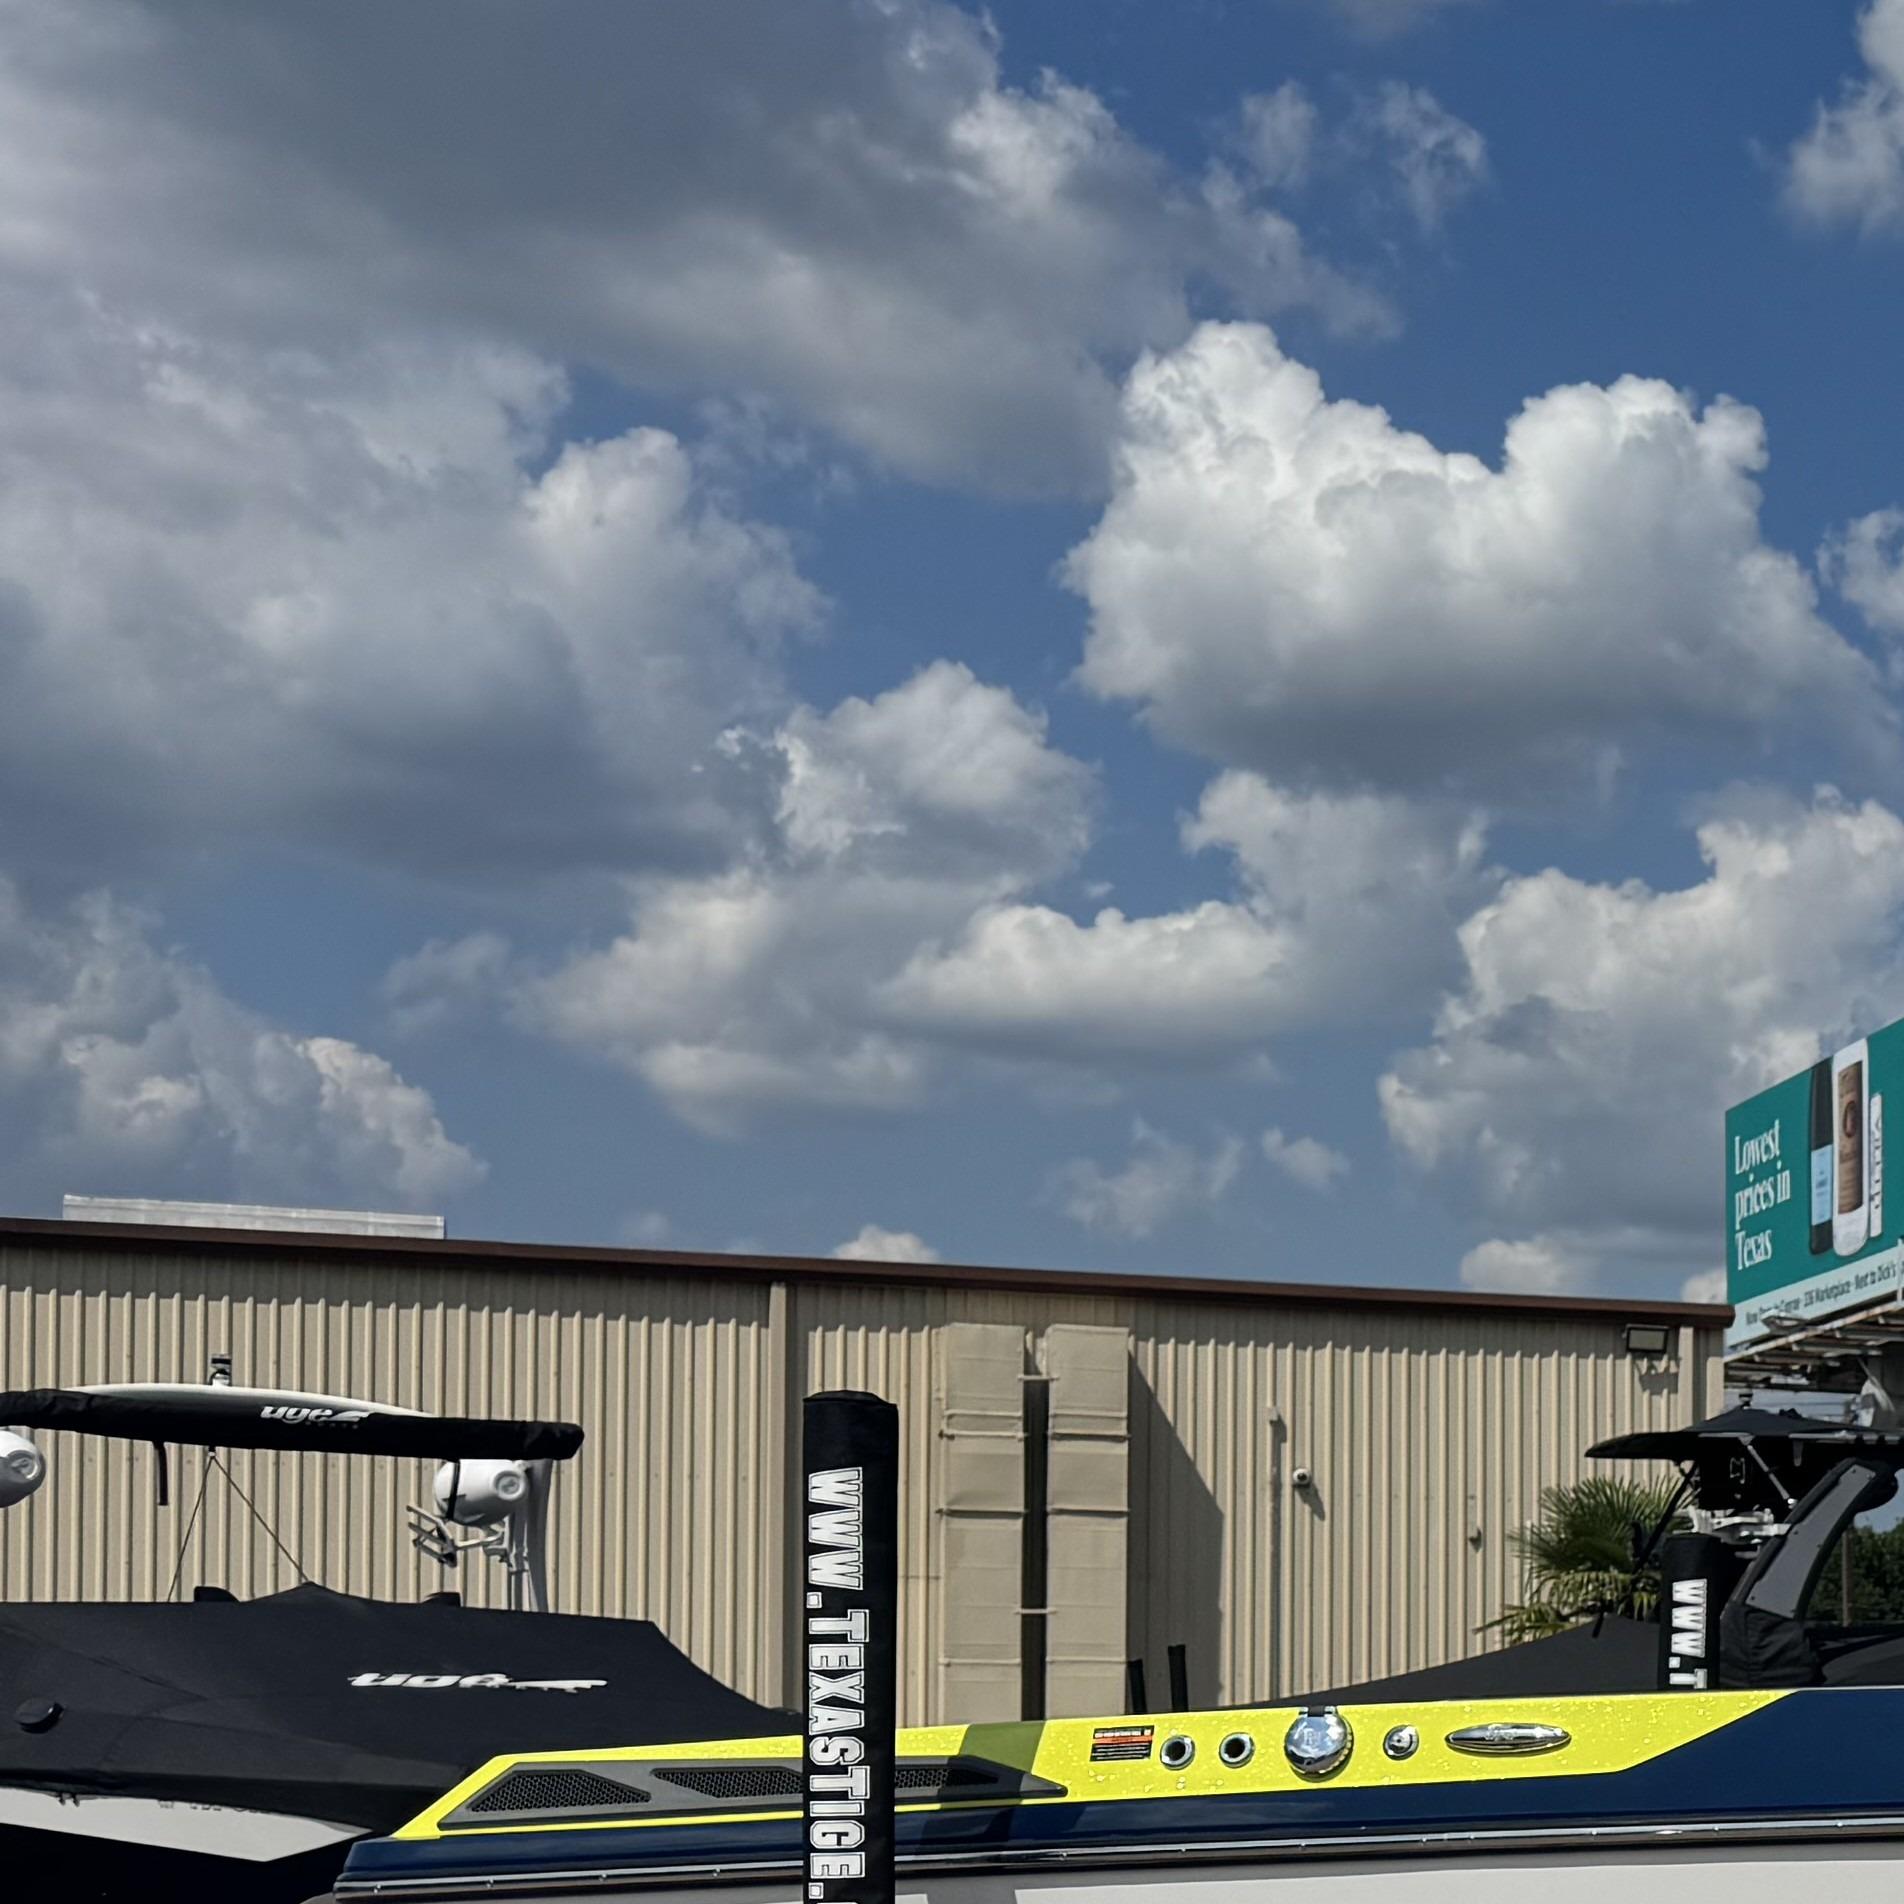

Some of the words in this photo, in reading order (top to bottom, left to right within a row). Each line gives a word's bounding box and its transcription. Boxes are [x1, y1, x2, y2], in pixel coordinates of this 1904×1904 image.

[1735, 1118, 1781, 1175] Lowest
[1735, 1173, 1775, 1231] prices
[1776, 1160, 1791, 1204] in
[1735, 1229, 1773, 1271] Texas
